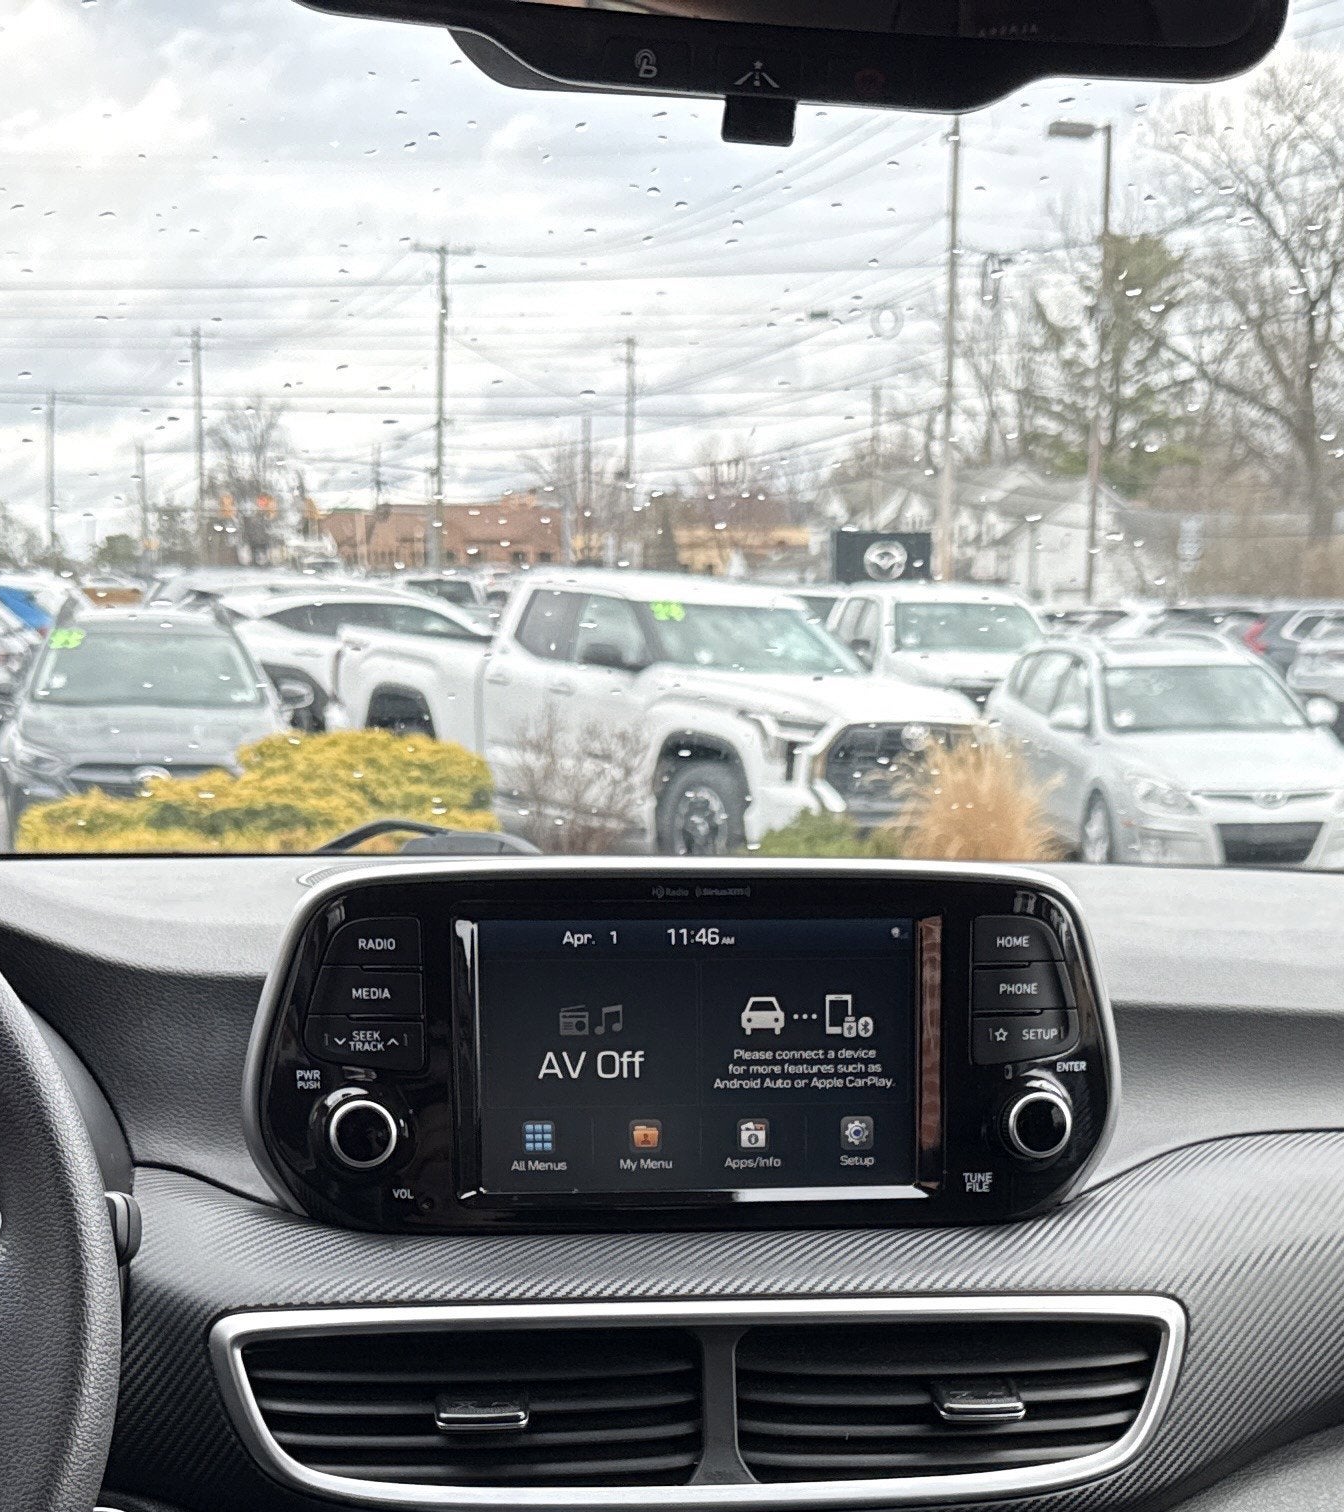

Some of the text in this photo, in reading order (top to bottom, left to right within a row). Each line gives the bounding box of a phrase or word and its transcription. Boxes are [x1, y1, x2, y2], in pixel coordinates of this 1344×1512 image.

[562, 930, 618, 948] Apr. 1
[666, 927, 736, 946] 11:46 AM
[996, 935, 1031, 948] HOME
[358, 938, 396, 951] RADIO
[351, 987, 392, 1000] MEDIA
[999, 983, 1039, 995] PHONE
[352, 1030, 381, 1041] SEEK
[1022, 1028, 1058, 1041] SETUP
[349, 1041, 385, 1052] TRACK
[733, 1048, 877, 1060] Please connect a device
[537, 1050, 646, 1080] AV Off
[728, 1062, 882, 1074] for more features such as
[1056, 1061, 1087, 1073] ENTER
[296, 1069, 321, 1080] PWR
[296, 1080, 321, 1090] PUSH
[713, 1076, 896, 1090] Android Auto or Apple CarPlay.
[510, 1159, 568, 1171] All Menus
[619, 1157, 674, 1172] My Menu
[839, 1154, 875, 1168] Setup
[963, 1171, 994, 1183] TUNE
[392, 1188, 415, 1199] VOL
[966, 1182, 991, 1193] FILE
